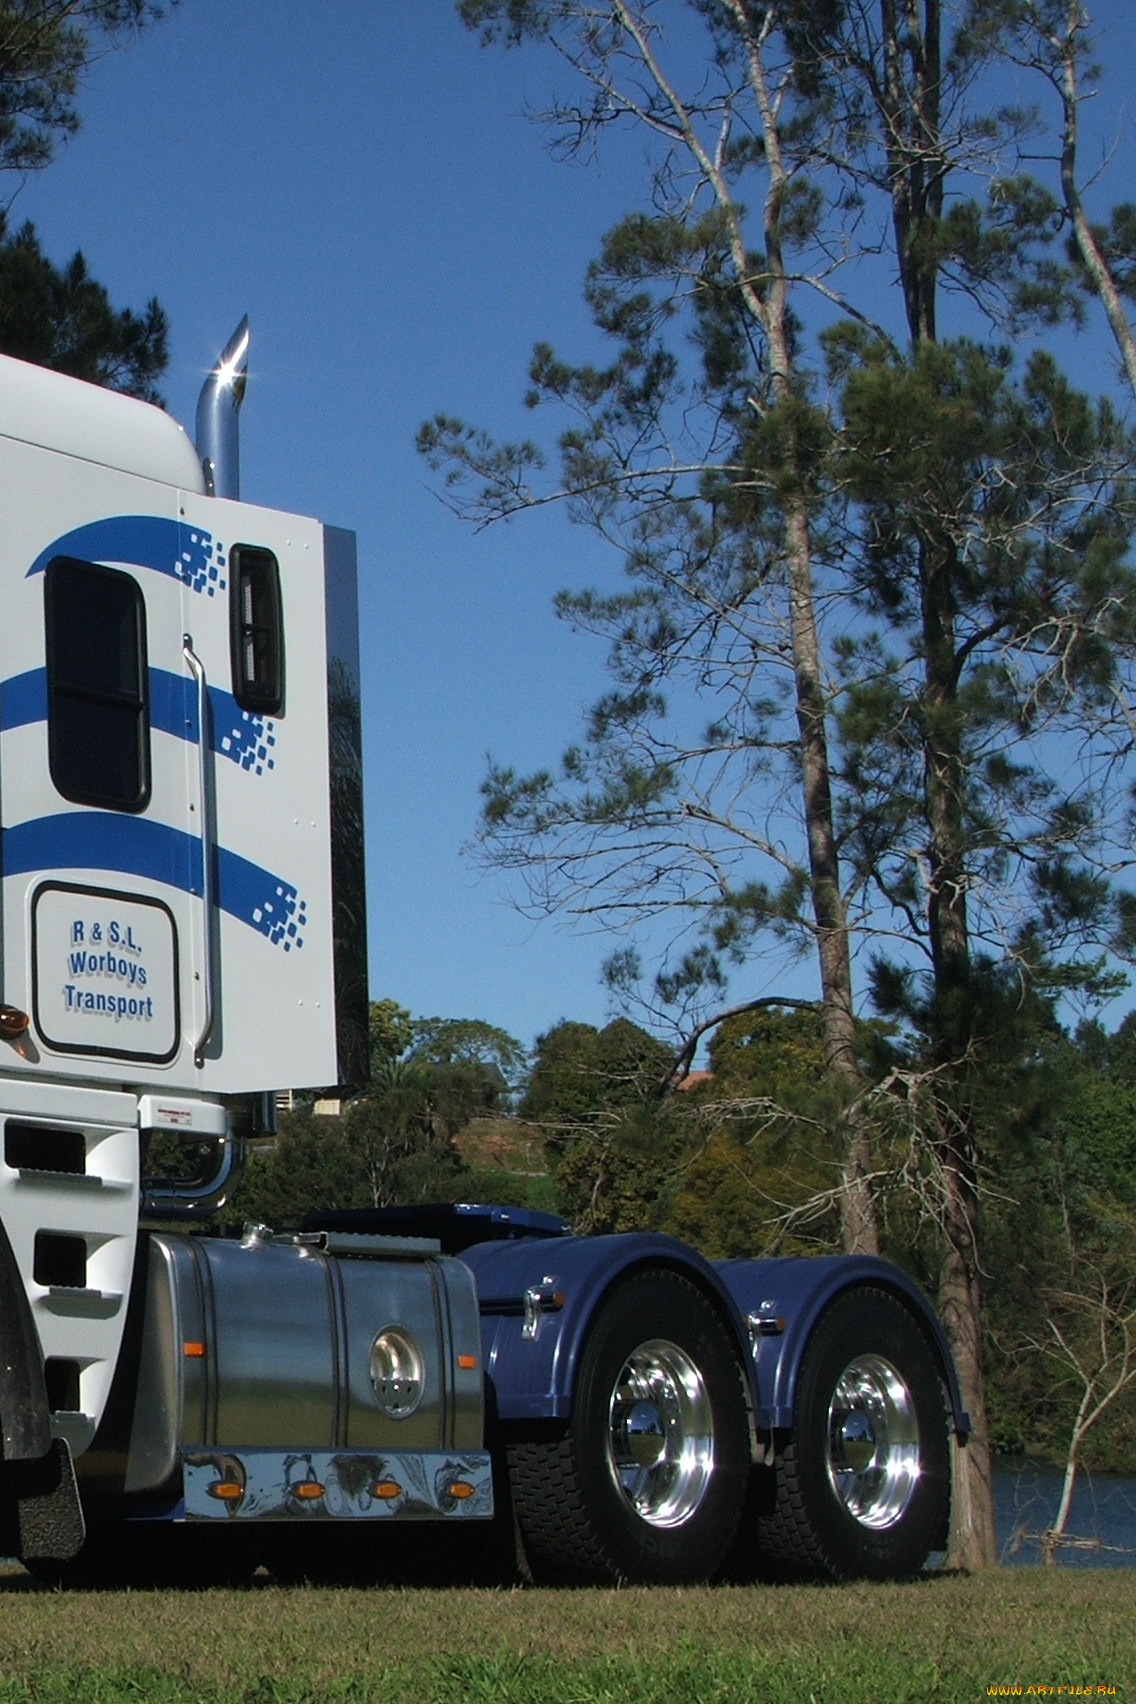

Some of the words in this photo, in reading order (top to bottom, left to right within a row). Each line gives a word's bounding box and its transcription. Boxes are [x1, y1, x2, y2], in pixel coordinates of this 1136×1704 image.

[73, 920, 84, 942] R
[92, 923, 103, 941] &
[110, 921, 143, 953] S.L.
[70, 951, 148, 985] Worboys
[65, 985, 154, 1018] Transport
